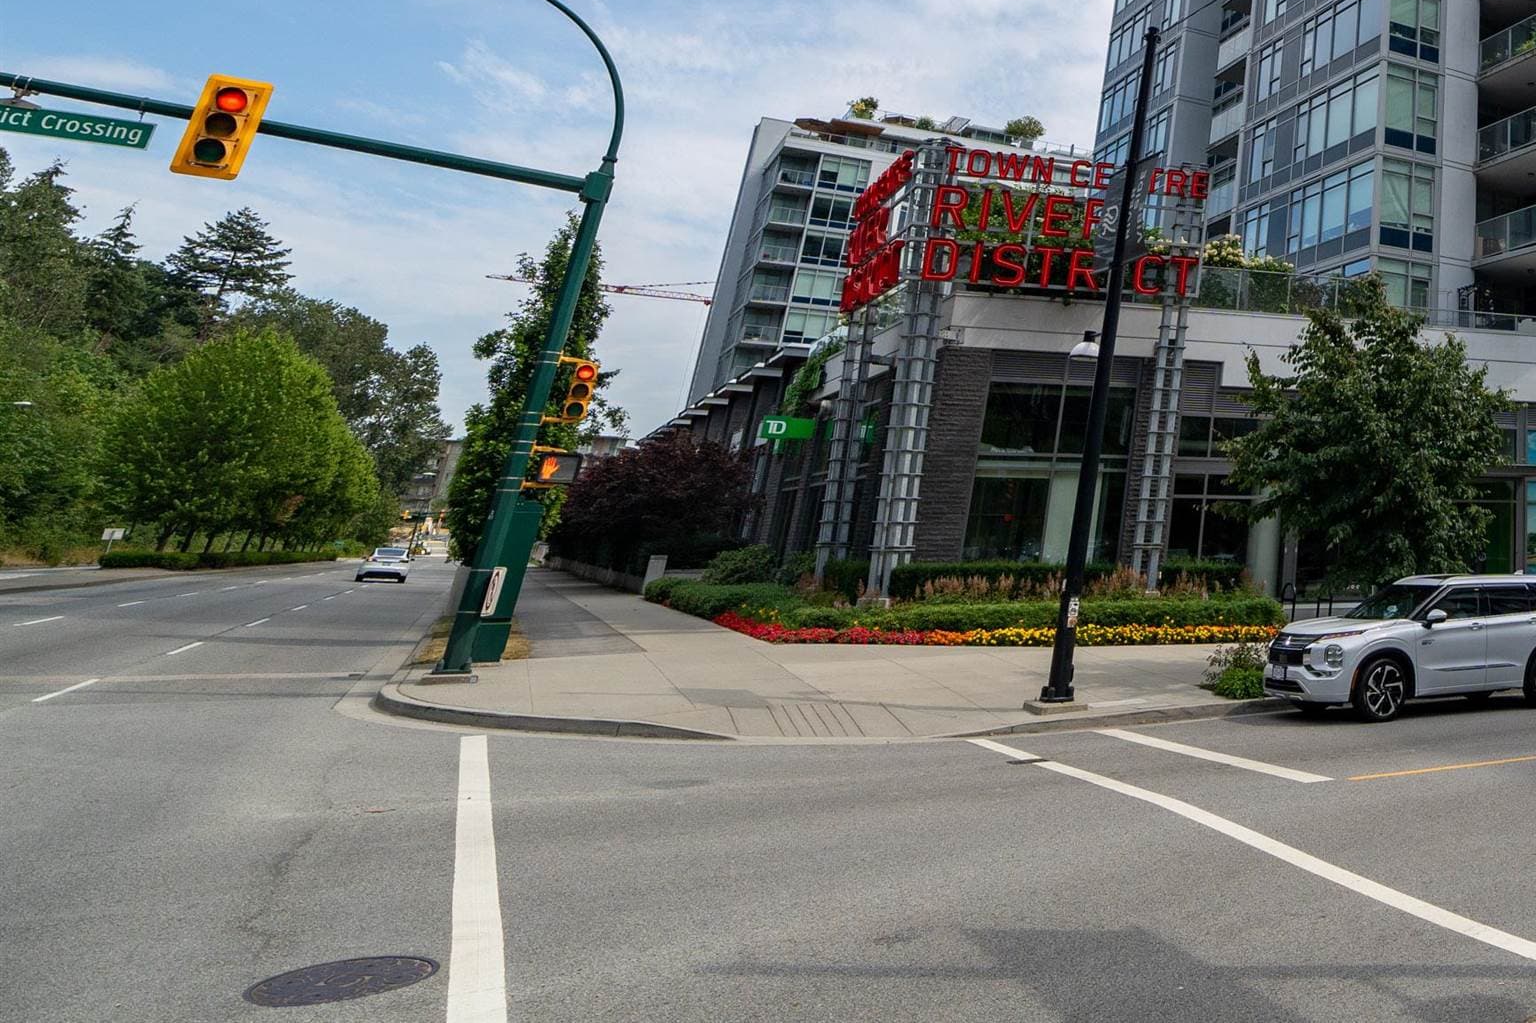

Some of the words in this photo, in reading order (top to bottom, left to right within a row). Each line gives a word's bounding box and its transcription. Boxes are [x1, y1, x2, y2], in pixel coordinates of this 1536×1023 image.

[0, 107, 32, 127] ict
[41, 114, 144, 145] Crossing
[945, 146, 1055, 186] TOWN
[1071, 159, 1211, 200] CETRE
[921, 236, 1200, 297] DISTRCT
[766, 420, 787, 435] TD
